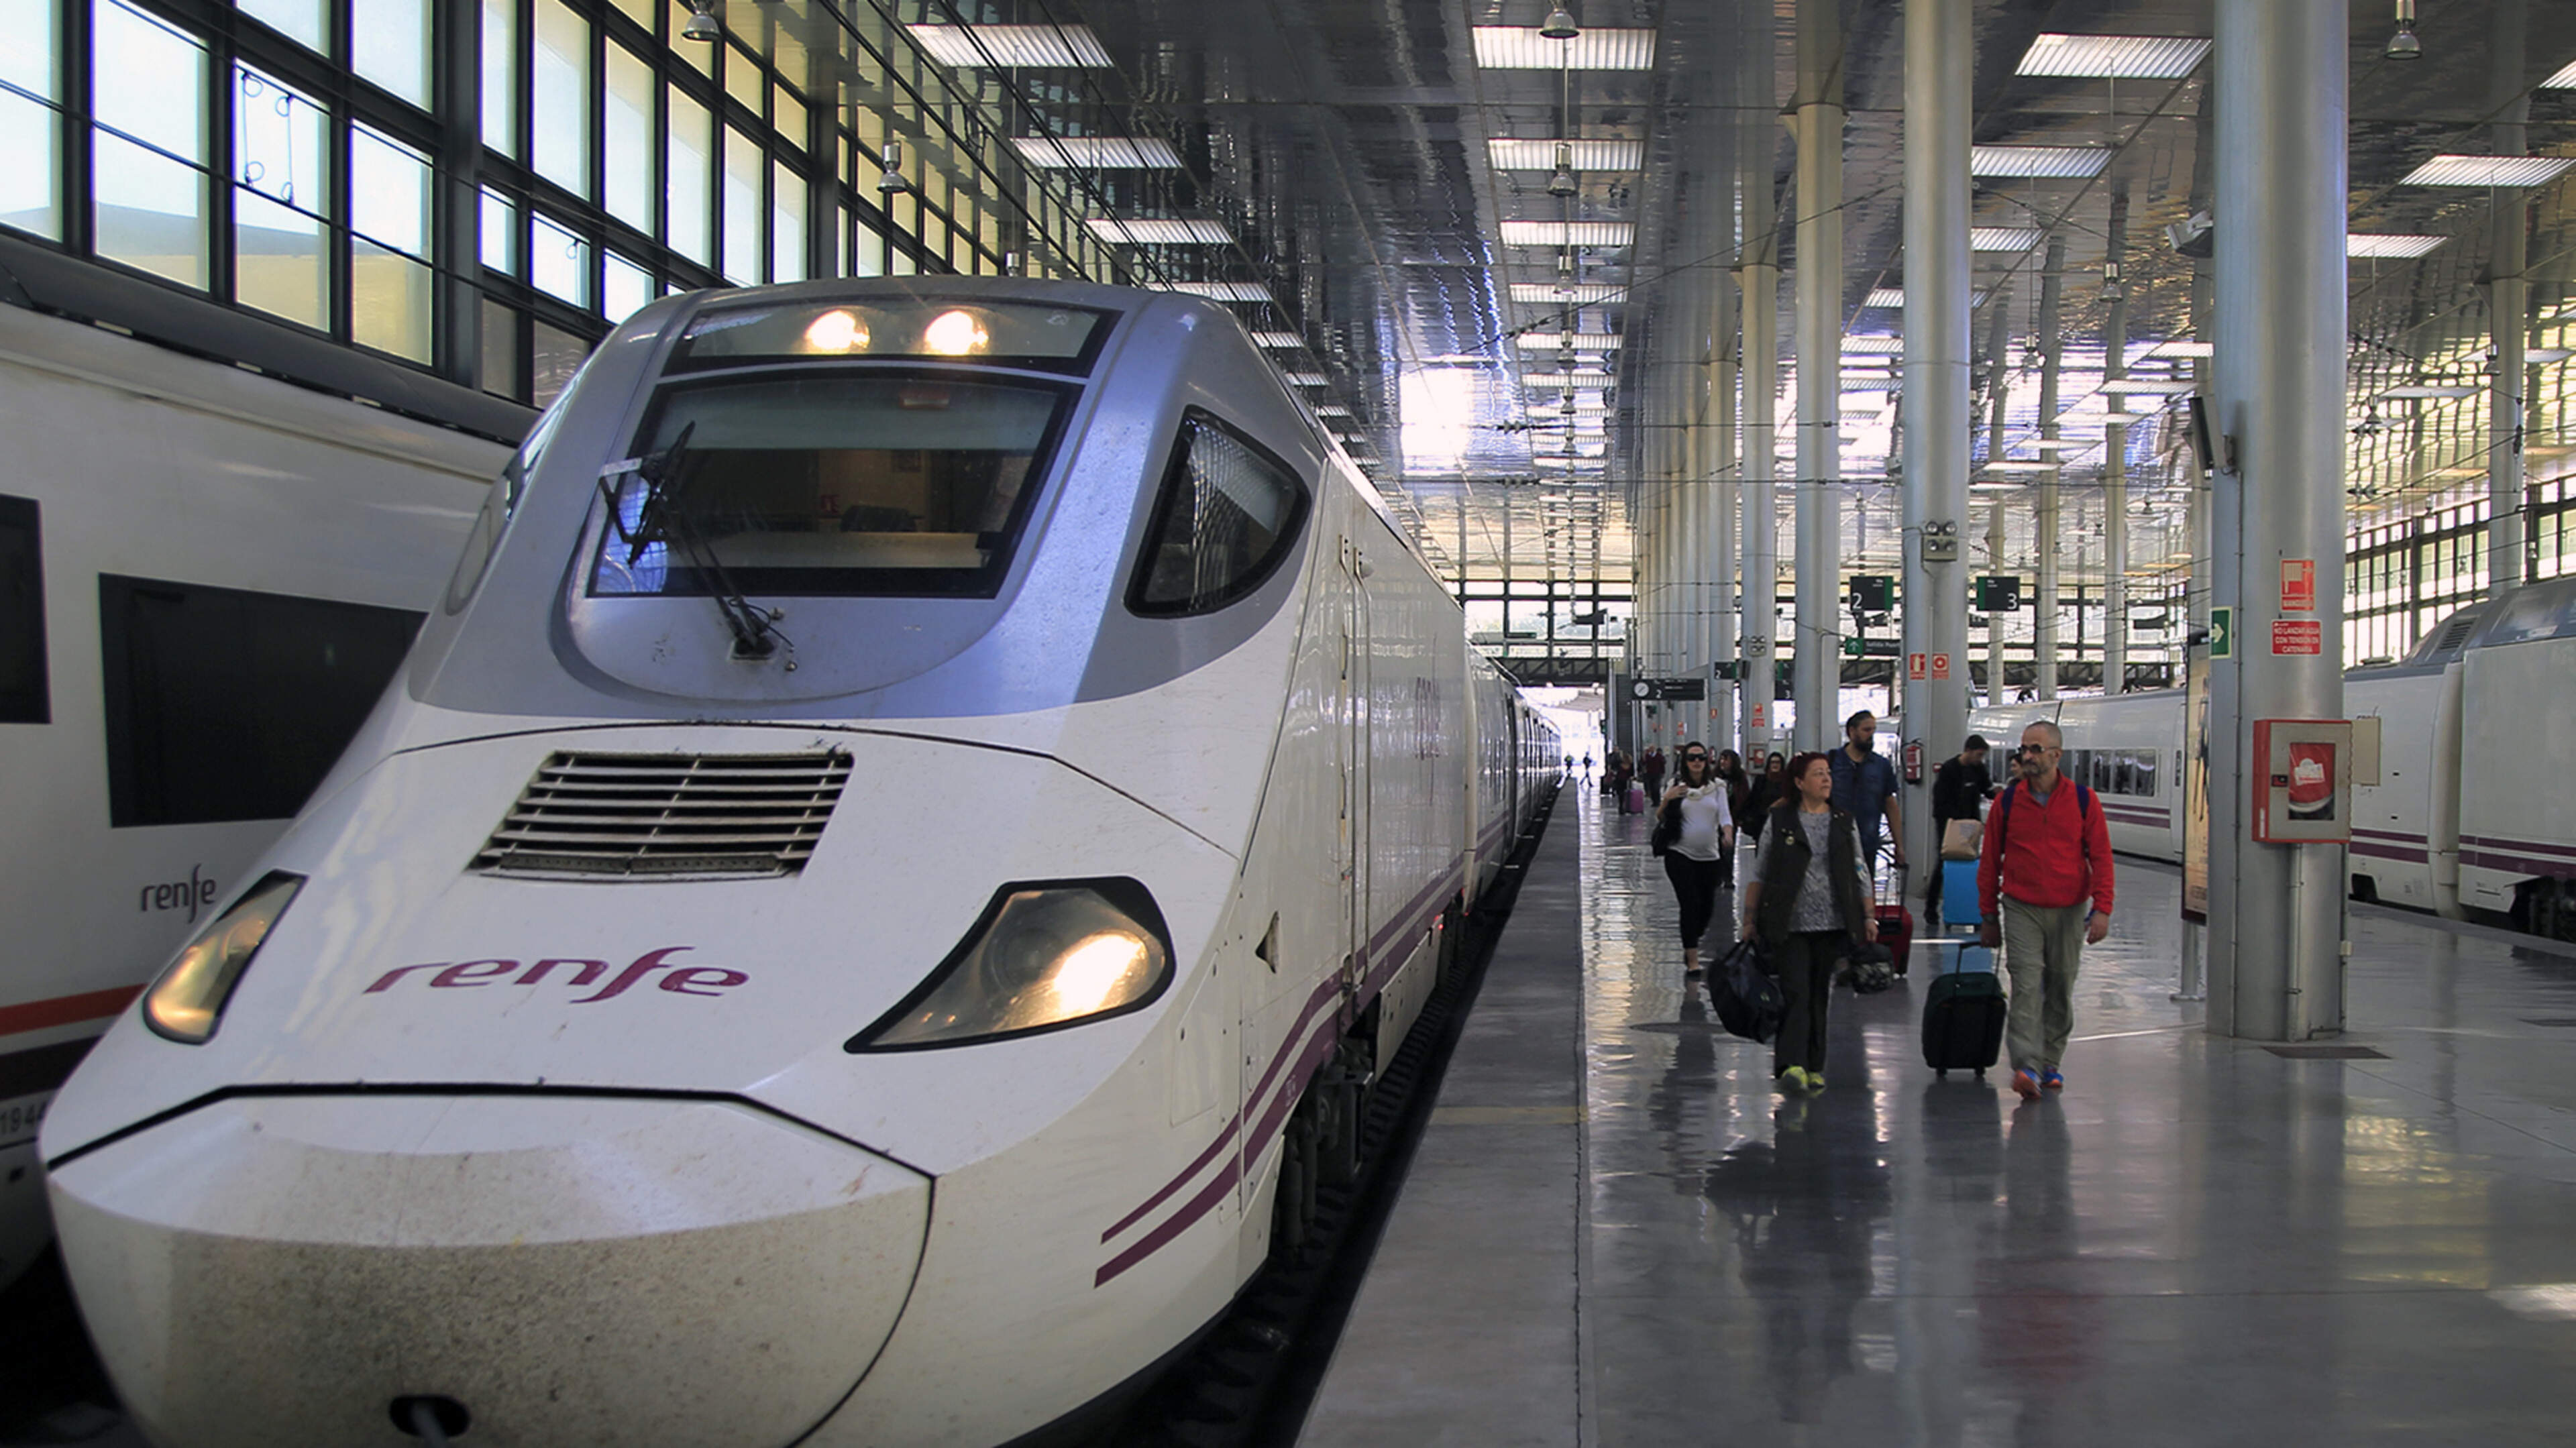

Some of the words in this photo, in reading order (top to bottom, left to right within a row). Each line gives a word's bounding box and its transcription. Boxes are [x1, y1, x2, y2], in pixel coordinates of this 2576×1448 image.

[1852, 592, 1862, 609] 2
[2007, 592, 2017, 610] 3
[1656, 689, 1662, 699] 2
[140, 864, 217, 924] renfe
[362, 946, 751, 1004] renfe
